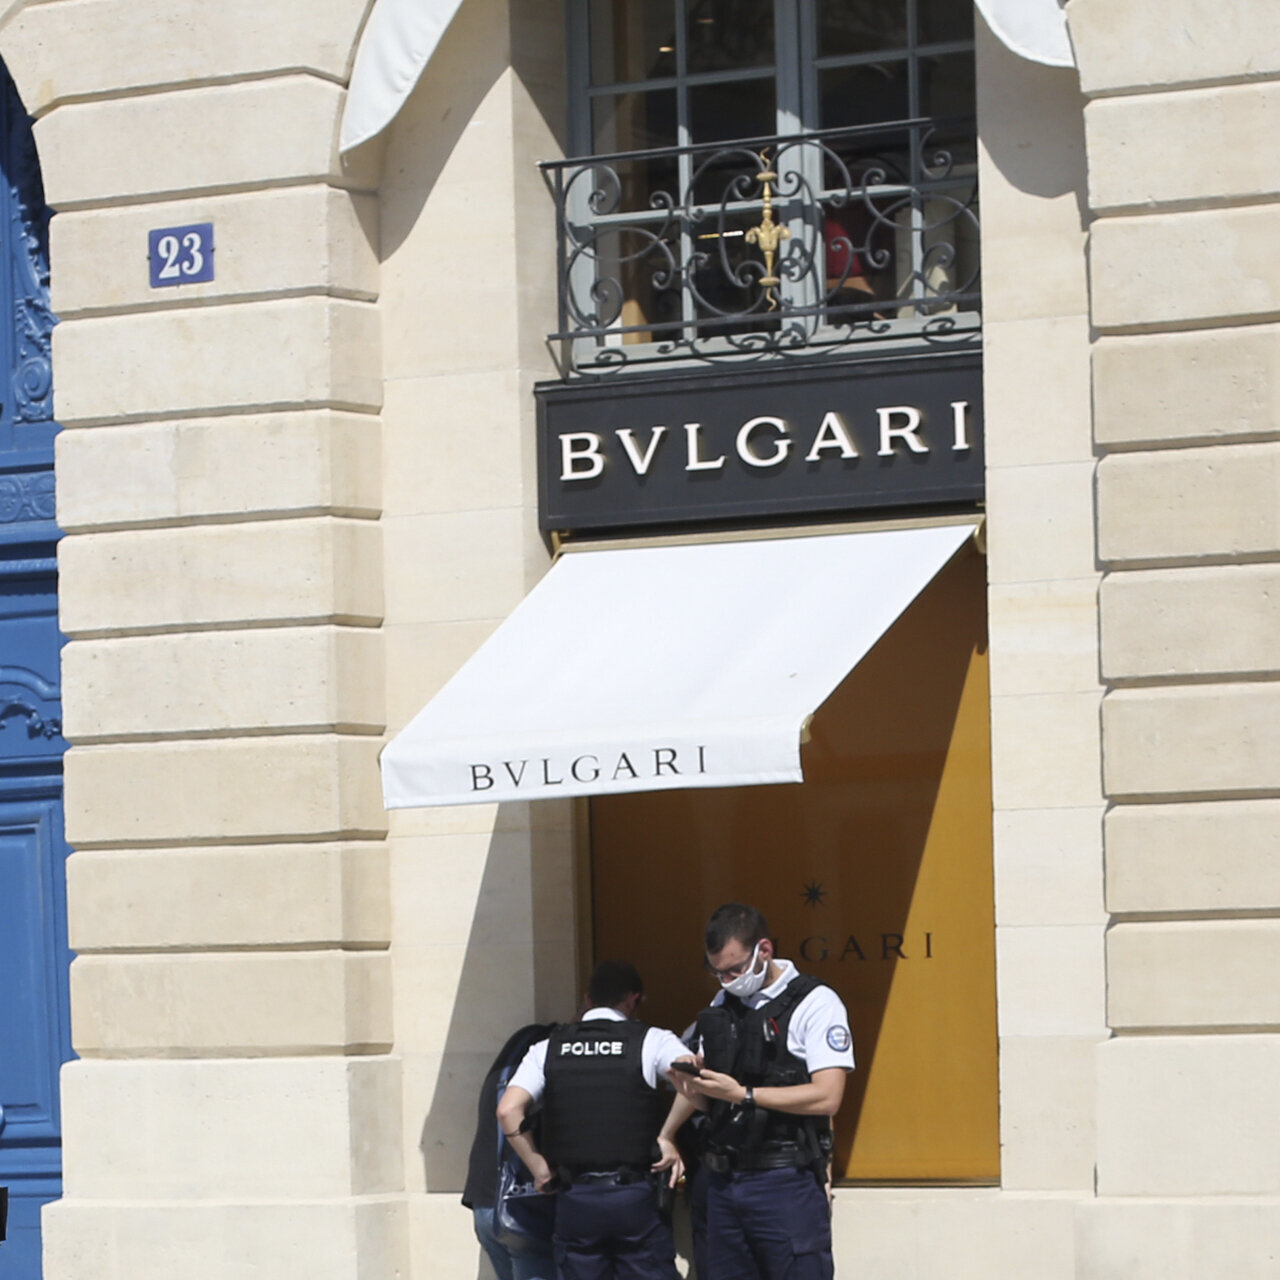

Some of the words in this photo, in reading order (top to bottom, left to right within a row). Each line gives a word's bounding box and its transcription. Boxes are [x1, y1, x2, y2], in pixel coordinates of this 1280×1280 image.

[158, 232, 203, 279] 23
[558, 401, 970, 481] BVLGARI
[469, 746, 706, 791] BVLGARI
[561, 1041, 623, 1056] POLICE
